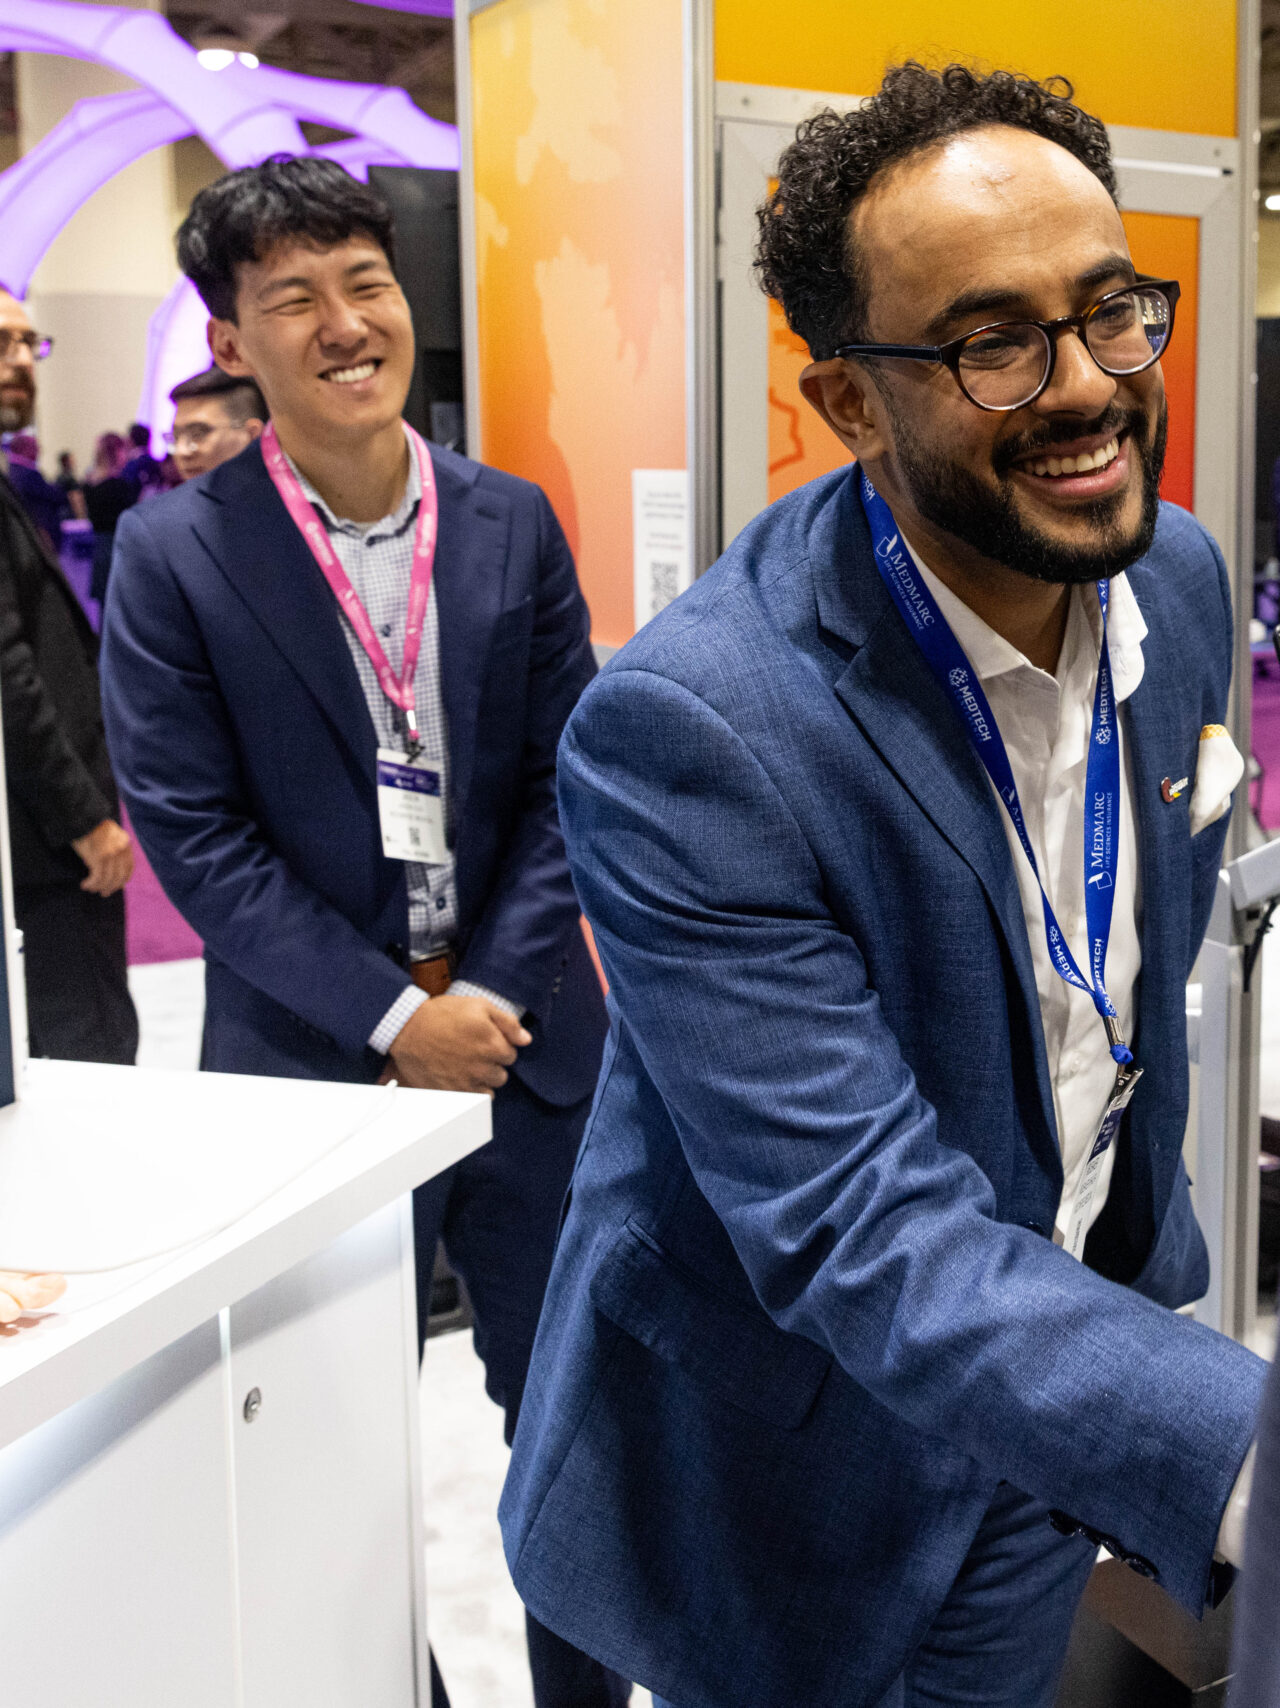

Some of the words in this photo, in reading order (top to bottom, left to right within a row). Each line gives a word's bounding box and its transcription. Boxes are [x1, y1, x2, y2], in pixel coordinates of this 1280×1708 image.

[890, 552, 935, 626] MEDMARC
[959, 685, 992, 742] MEDTECH
[1100, 668, 1108, 725] MEDTECH
[1091, 792, 1105, 868] MEDMARC
